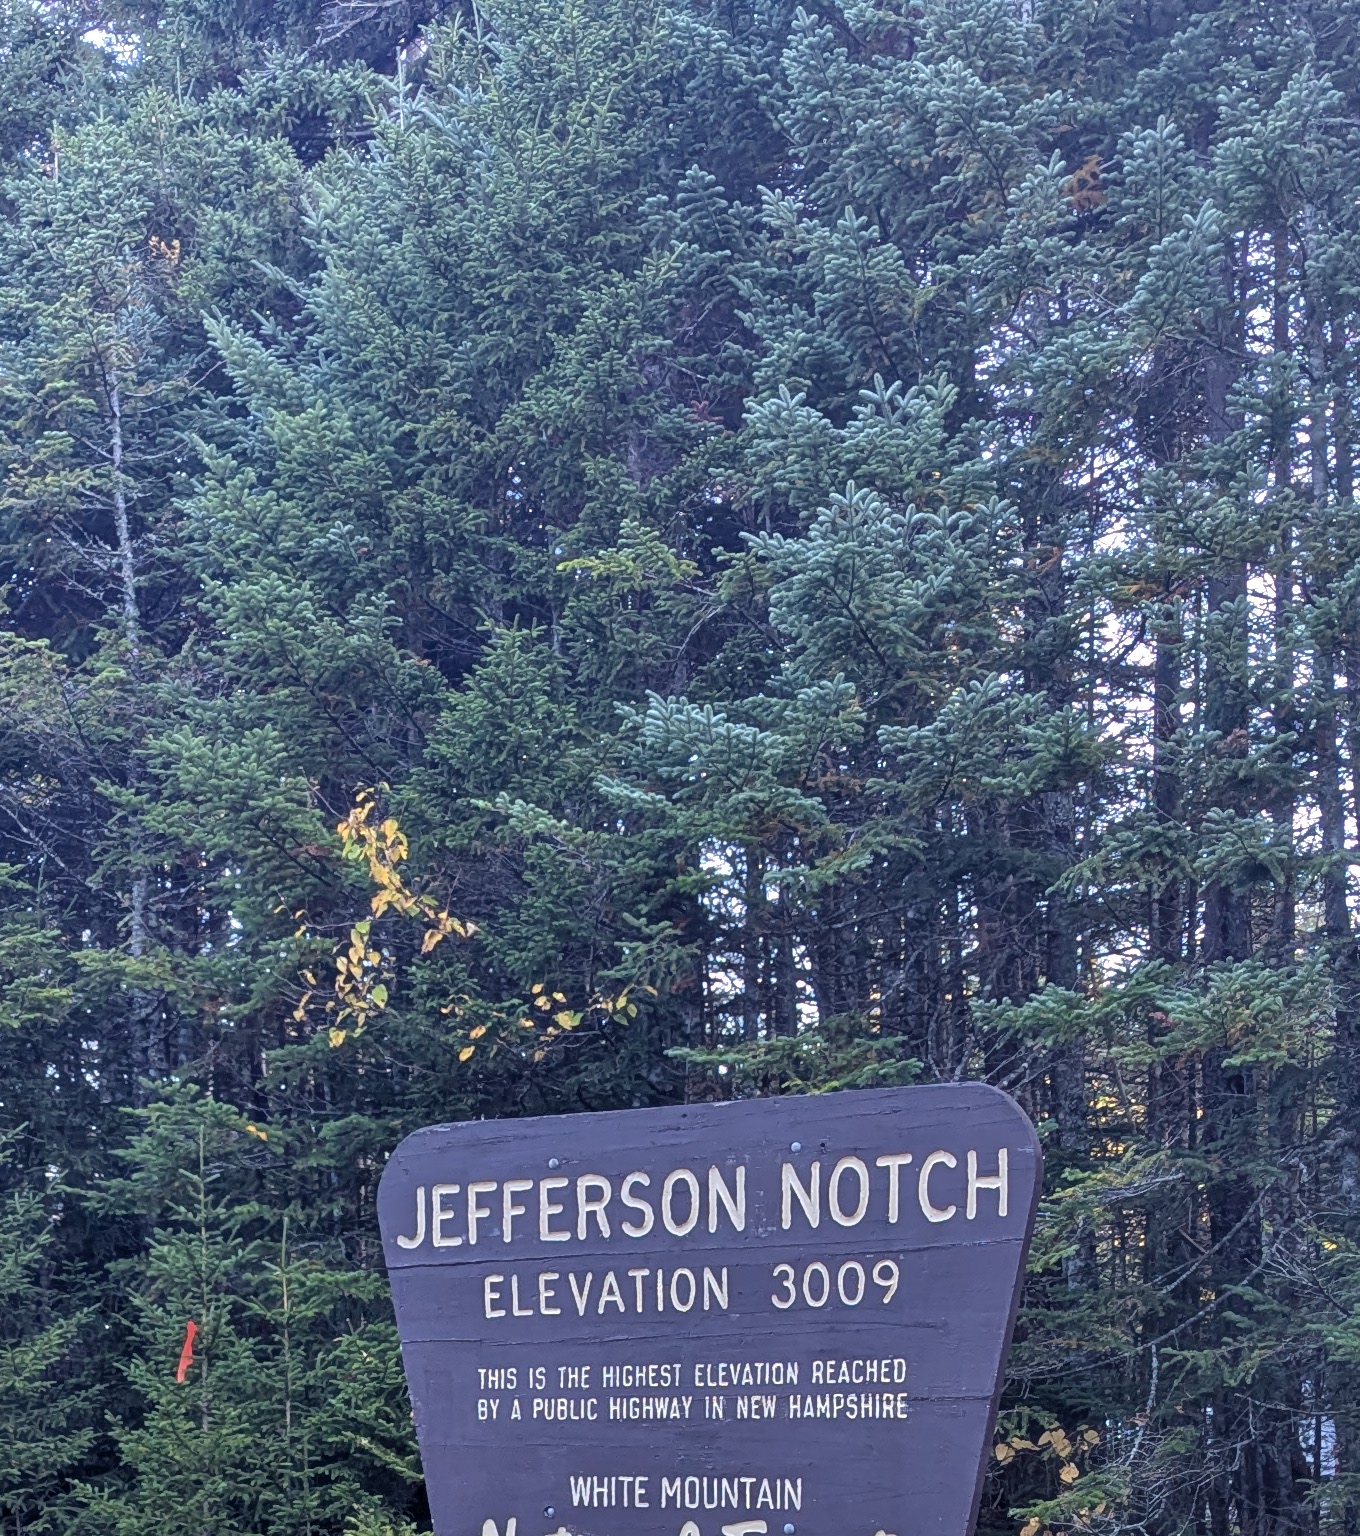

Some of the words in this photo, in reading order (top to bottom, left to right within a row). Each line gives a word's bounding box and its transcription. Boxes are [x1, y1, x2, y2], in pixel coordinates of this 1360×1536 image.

[396, 1164, 746, 1250] JEFFERSON
[781, 1148, 1009, 1230] NOTCH
[484, 1267, 730, 1319] ELEVATION
[771, 1259, 900, 1309] 3009
[477, 1368, 517, 1390] THIS
[529, 1367, 547, 1390] IS
[557, 1366, 591, 1389] THE
[602, 1364, 682, 1388] HIGHEST
[694, 1362, 799, 1387] ELEVATION
[811, 1359, 907, 1385] REACHED
[477, 1398, 500, 1421] BY
[510, 1399, 522, 1421] A
[532, 1397, 598, 1421] PUBLIC
[609, 1396, 693, 1420] HIGHWAY
[704, 1395, 724, 1420] IN
[736, 1394, 777, 1420] NEW
[789, 1392, 909, 1420] HAMPSHIRE
[569, 1475, 650, 1508] WHITE
[660, 1475, 802, 1511] MOUNTAIN
